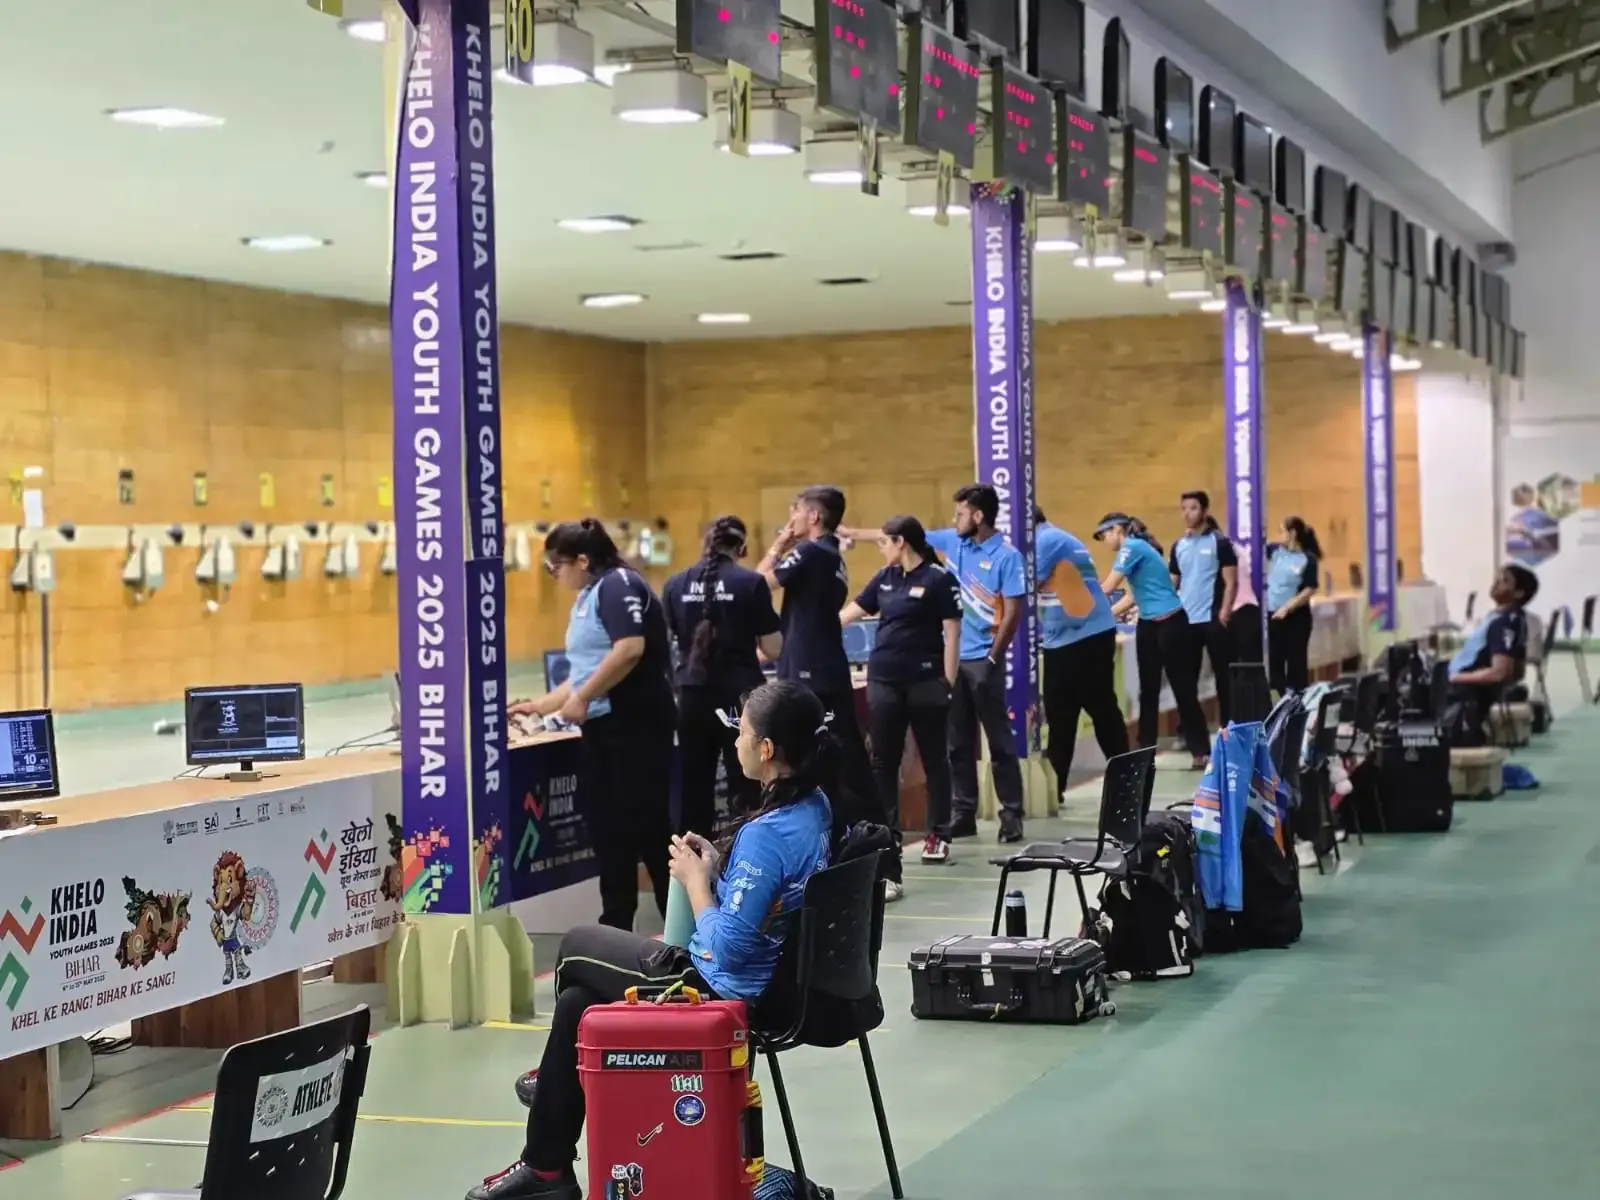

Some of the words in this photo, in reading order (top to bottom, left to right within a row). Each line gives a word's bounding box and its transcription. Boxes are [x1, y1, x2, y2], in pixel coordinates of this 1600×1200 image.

[407, 24, 435, 149] KHELO
[466, 23, 485, 149] KHELO
[409, 161, 438, 272] INDIA
[469, 161, 488, 271] INDIA
[985, 226, 1005, 302] KHELO
[412, 281, 440, 415] YOUTH
[474, 287, 493, 412] YOUTH
[987, 307, 1006, 375] INDIA
[990, 380, 1009, 460] YOUTH
[1023, 378, 1032, 456] YOUTH
[414, 427, 442, 561] GAMES
[478, 425, 497, 559] GAMES
[1024, 463, 1033, 543] GAMES
[416, 575, 444, 669] 2025
[479, 571, 497, 666] 2025
[690, 580, 725, 594] INA
[23, 753, 37, 765] 10
[418, 684, 447, 798] BIHAR
[482, 679, 500, 795] BIHAR
[339, 845, 378, 874] इंडिया
[340, 817, 373, 846] खेलो
[50, 908, 98, 945] INDIA
[51, 878, 105, 916] KHELO
[345, 888, 377, 911] बिहार
[50, 946, 73, 960] YOUTH
[74, 940, 98, 954] GAMES
[98, 936, 114, 947] 2025
[65, 955, 101, 979] BIHAR
[11, 1011, 40, 1031] KHEL
[43, 1005, 57, 1022] KE
[61, 994, 94, 1017] RANG!
[97, 985, 127, 1007] BIHAR
[130, 980, 143, 996] KE
[146, 971, 176, 991] SANG!
[291, 1072, 334, 1117] ATHLETE
[607, 1054, 667, 1066] PELICAN
[670, 1055, 698, 1066] AIR
